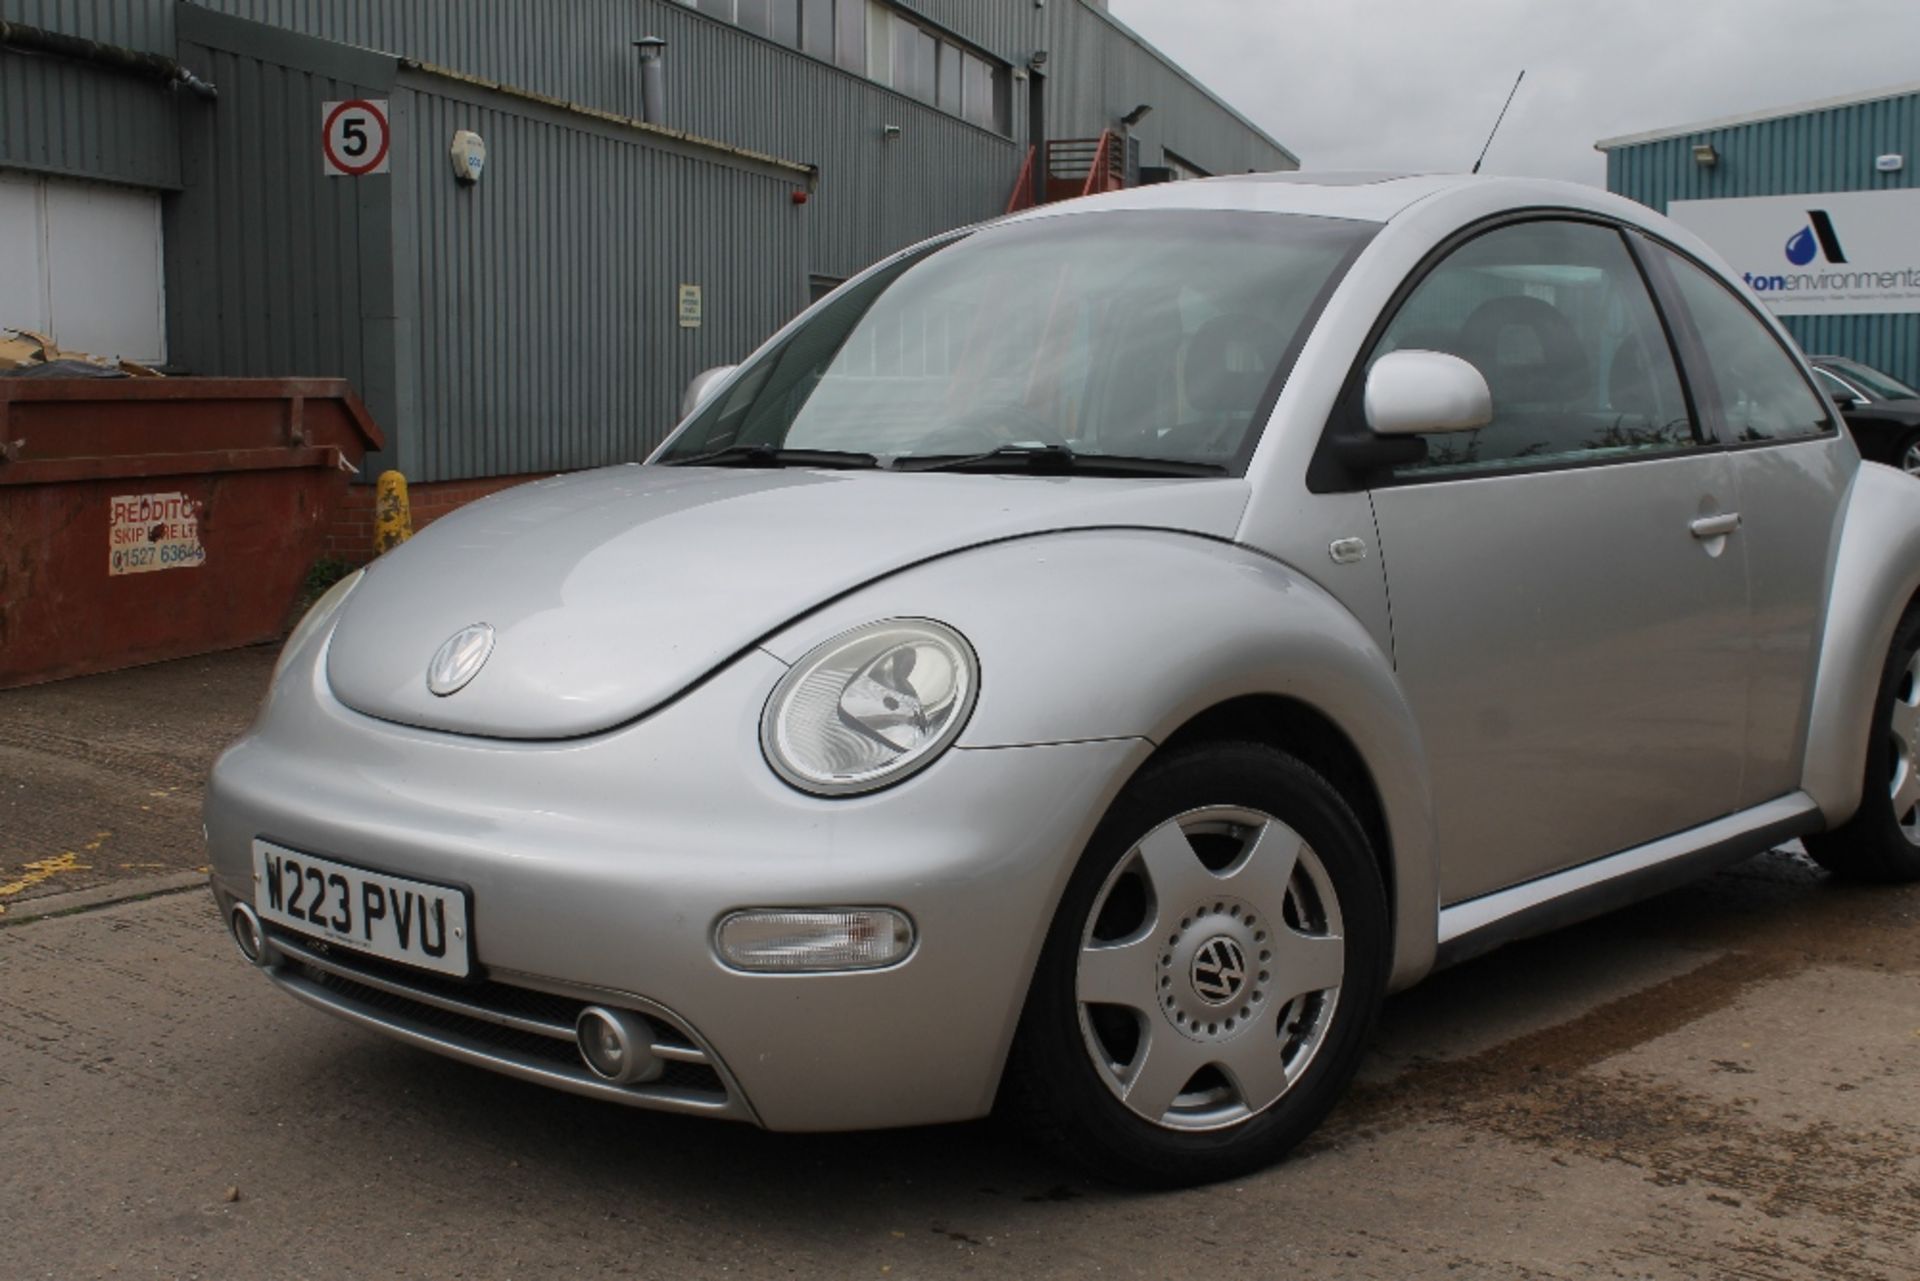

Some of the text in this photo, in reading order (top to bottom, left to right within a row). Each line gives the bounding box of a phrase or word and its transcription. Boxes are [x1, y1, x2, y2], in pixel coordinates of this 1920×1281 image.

[342, 118, 367, 157] 5
[114, 527, 145, 544] SKIP
[264, 852, 446, 958] W223 PVU
